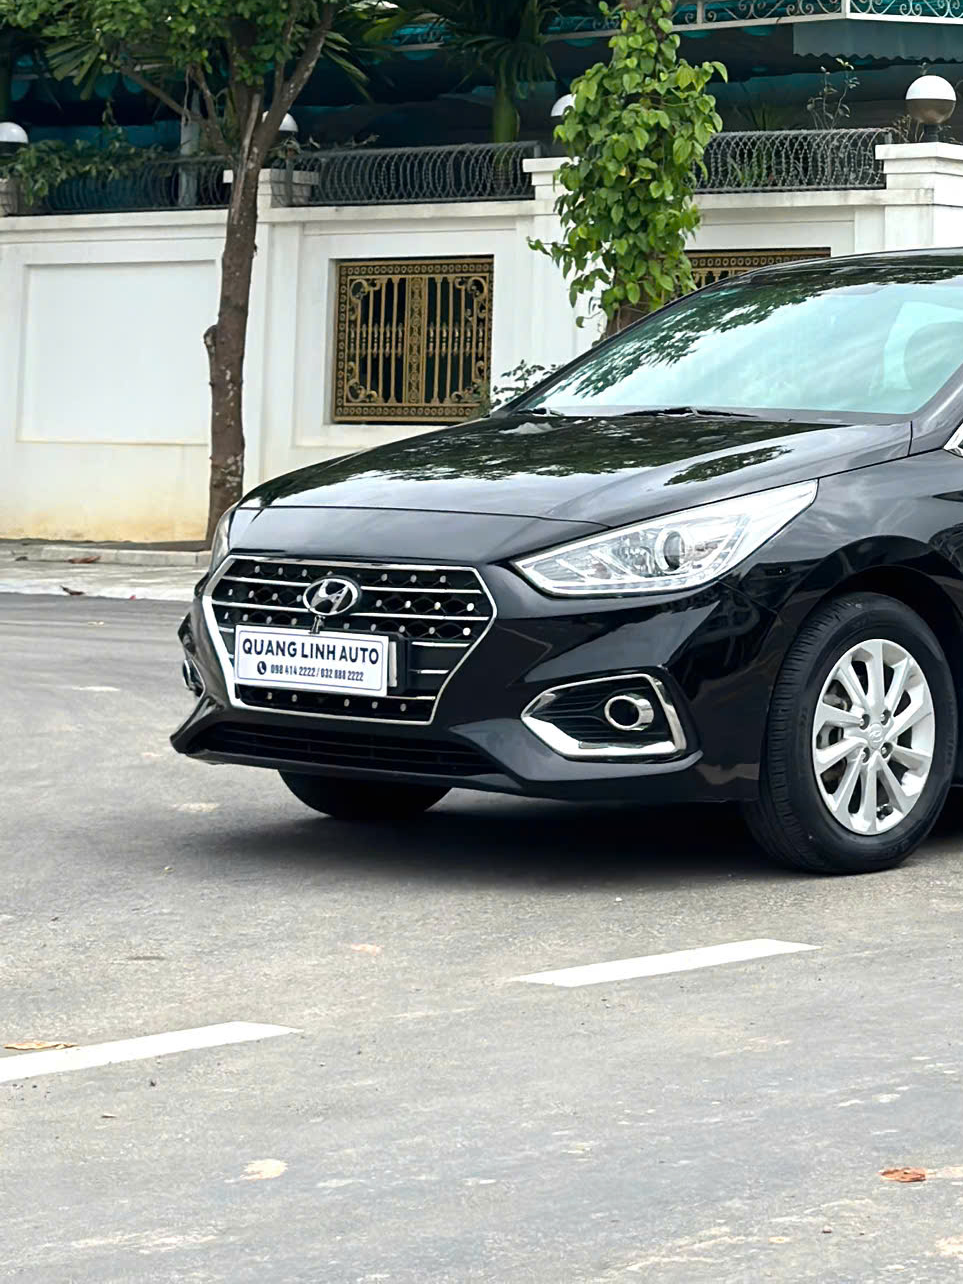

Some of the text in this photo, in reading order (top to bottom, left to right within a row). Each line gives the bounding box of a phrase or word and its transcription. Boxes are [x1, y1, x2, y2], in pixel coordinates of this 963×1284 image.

[242, 638, 379, 665] QUANG LINH AUTO
[347, 670, 364, 682] 2222
